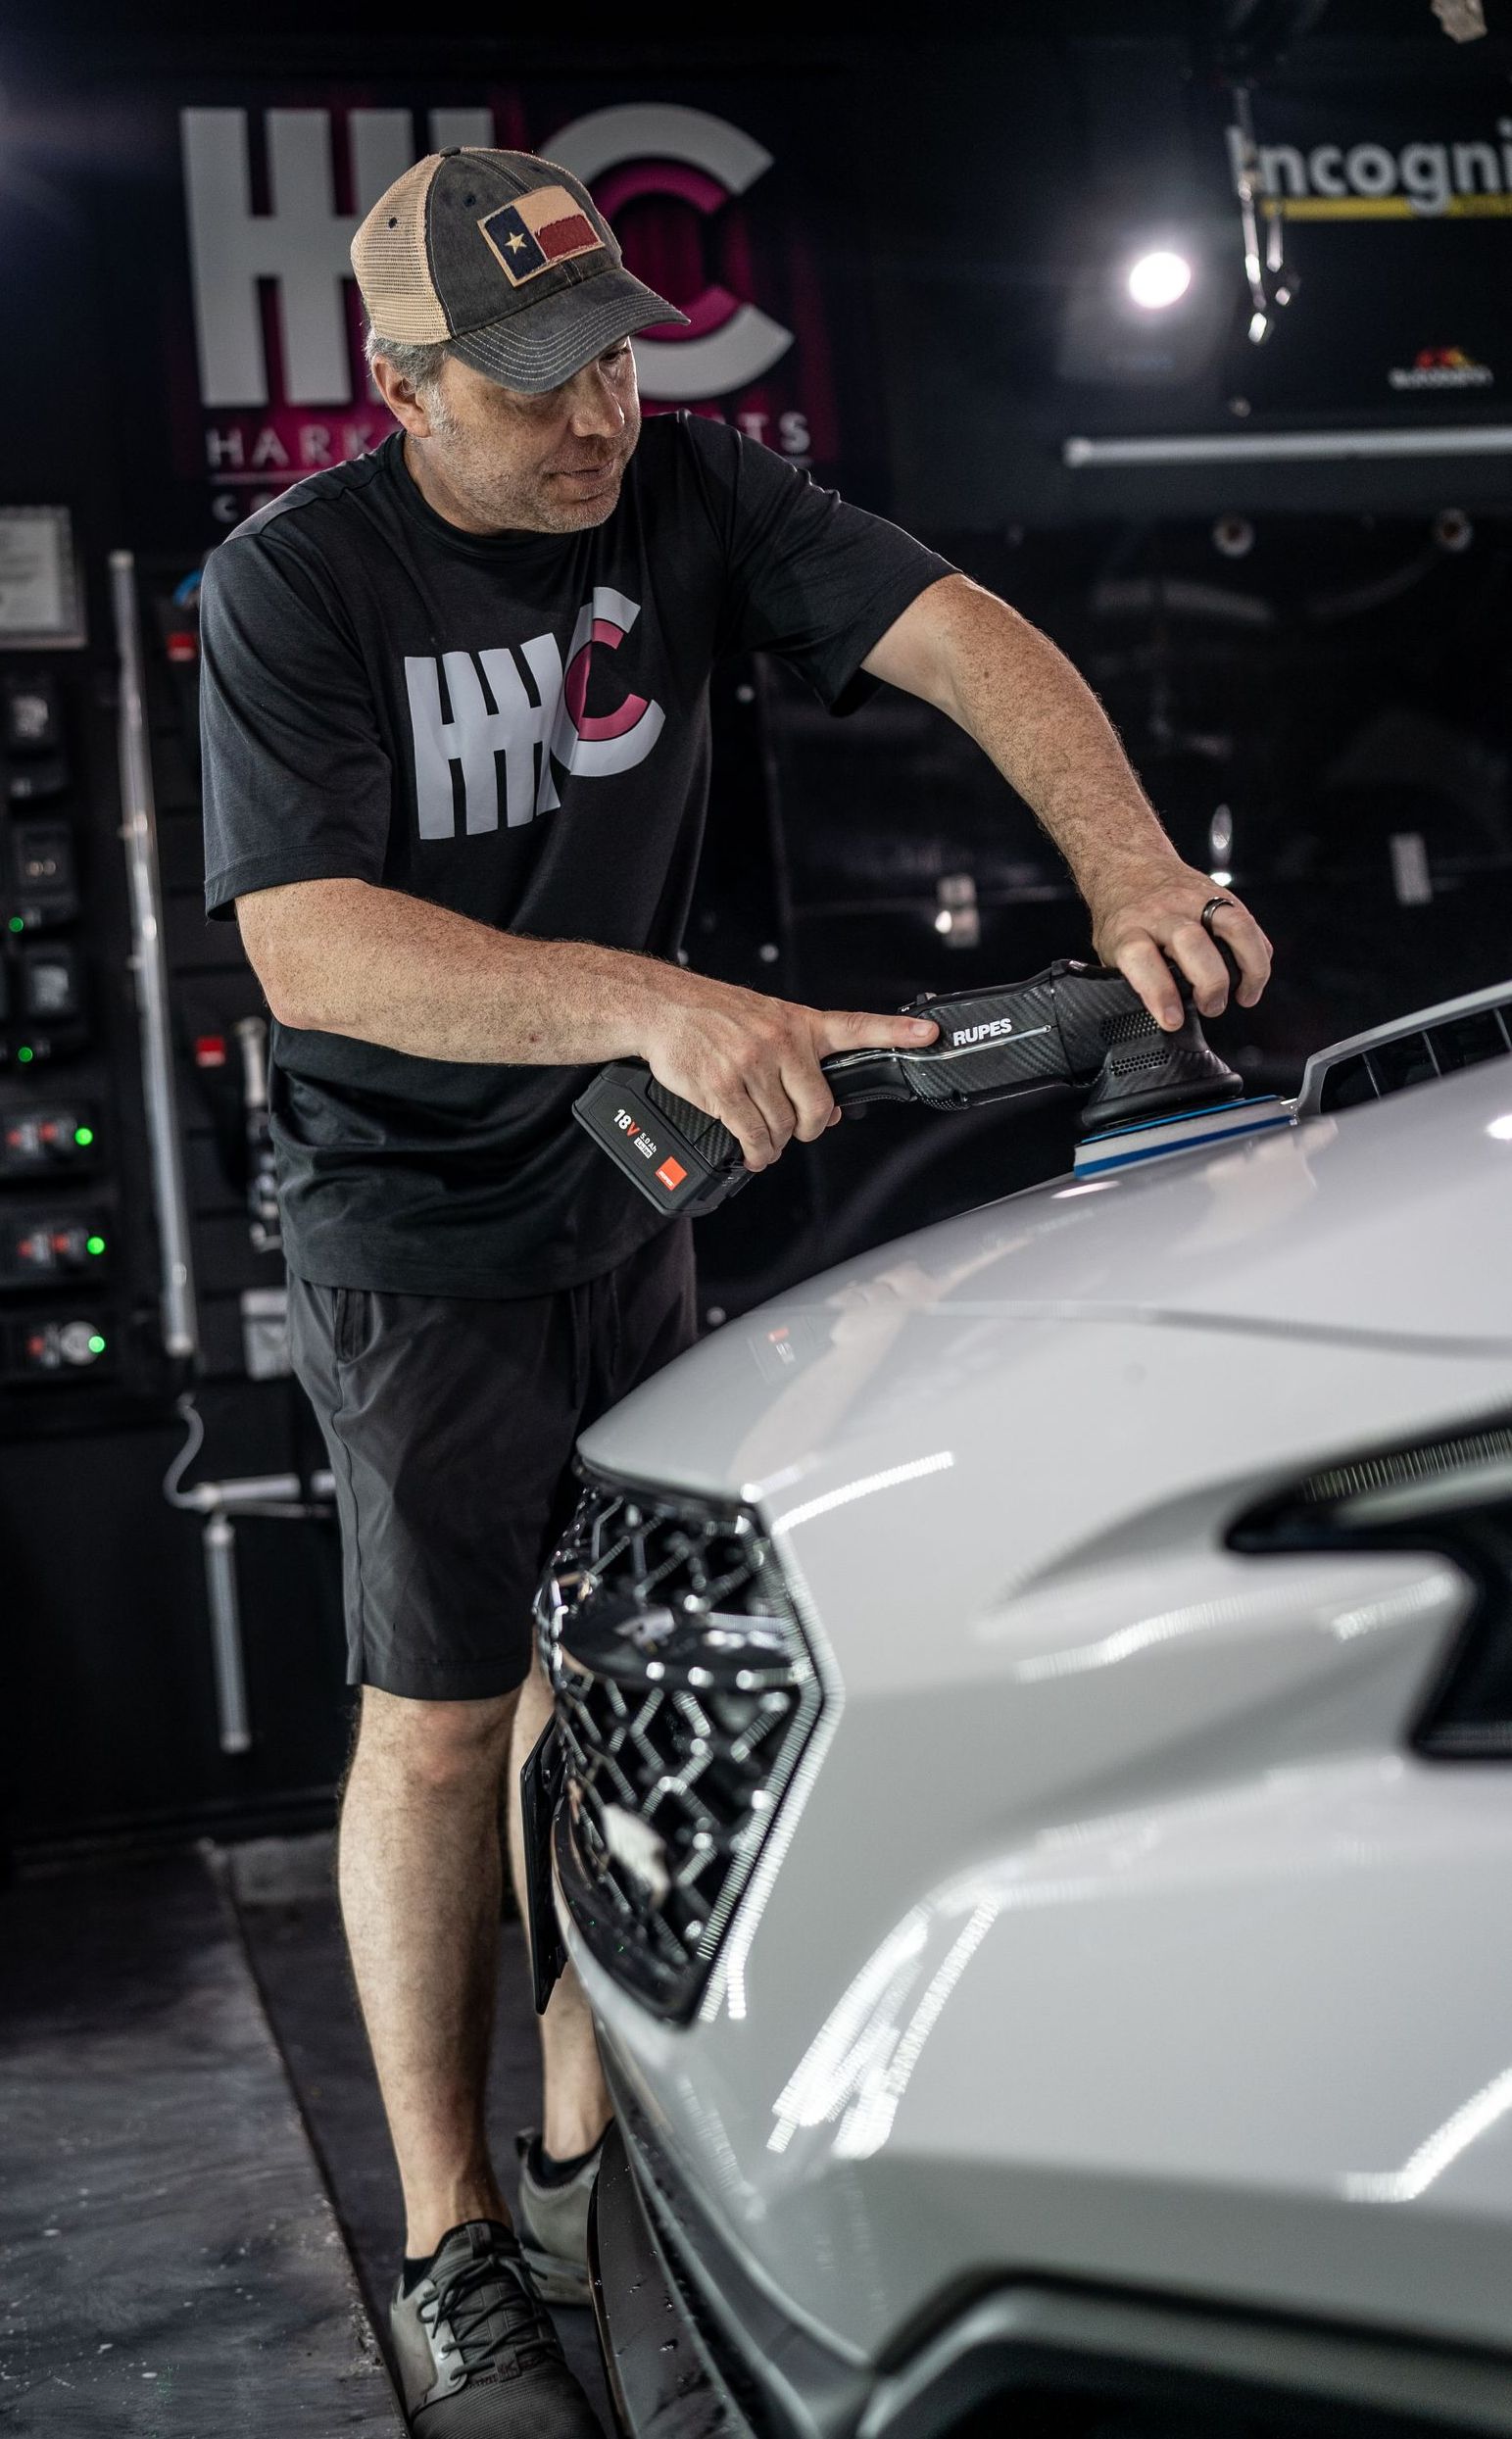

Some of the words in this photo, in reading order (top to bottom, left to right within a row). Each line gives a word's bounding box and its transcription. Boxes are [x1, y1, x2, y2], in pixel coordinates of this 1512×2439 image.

[206, 423, 390, 468] HARK
[952, 1018, 1012, 1047] RUPES
[613, 1108, 641, 1137] 18V
